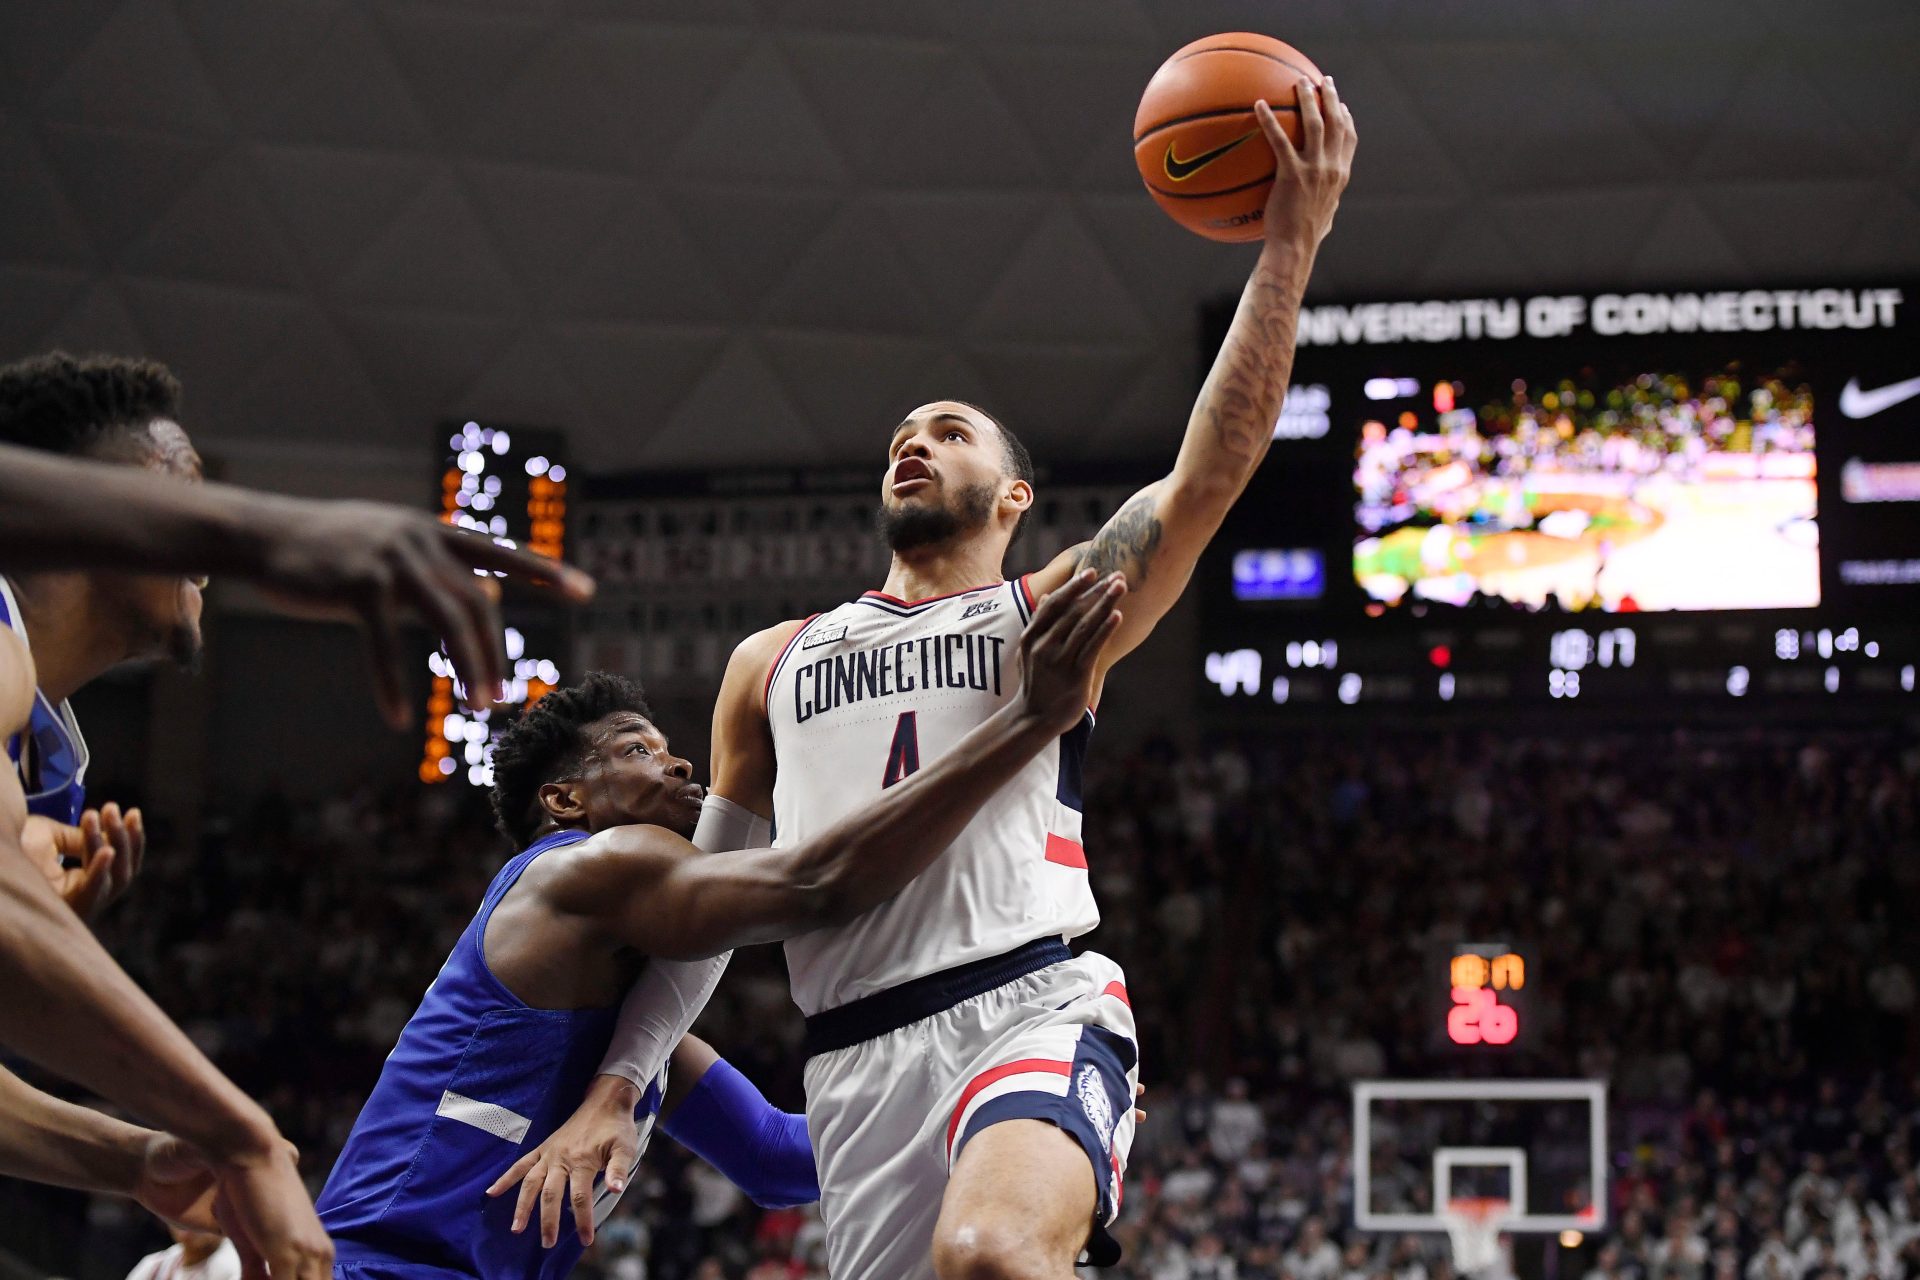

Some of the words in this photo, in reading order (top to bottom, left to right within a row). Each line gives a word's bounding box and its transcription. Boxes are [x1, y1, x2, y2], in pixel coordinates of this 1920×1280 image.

[1297, 302, 1521, 345] NIVERSITY
[1525, 296, 1588, 338] OF
[1592, 288, 1903, 335] CONNECTICUT
[795, 633, 1004, 724] CONNECTICUT
